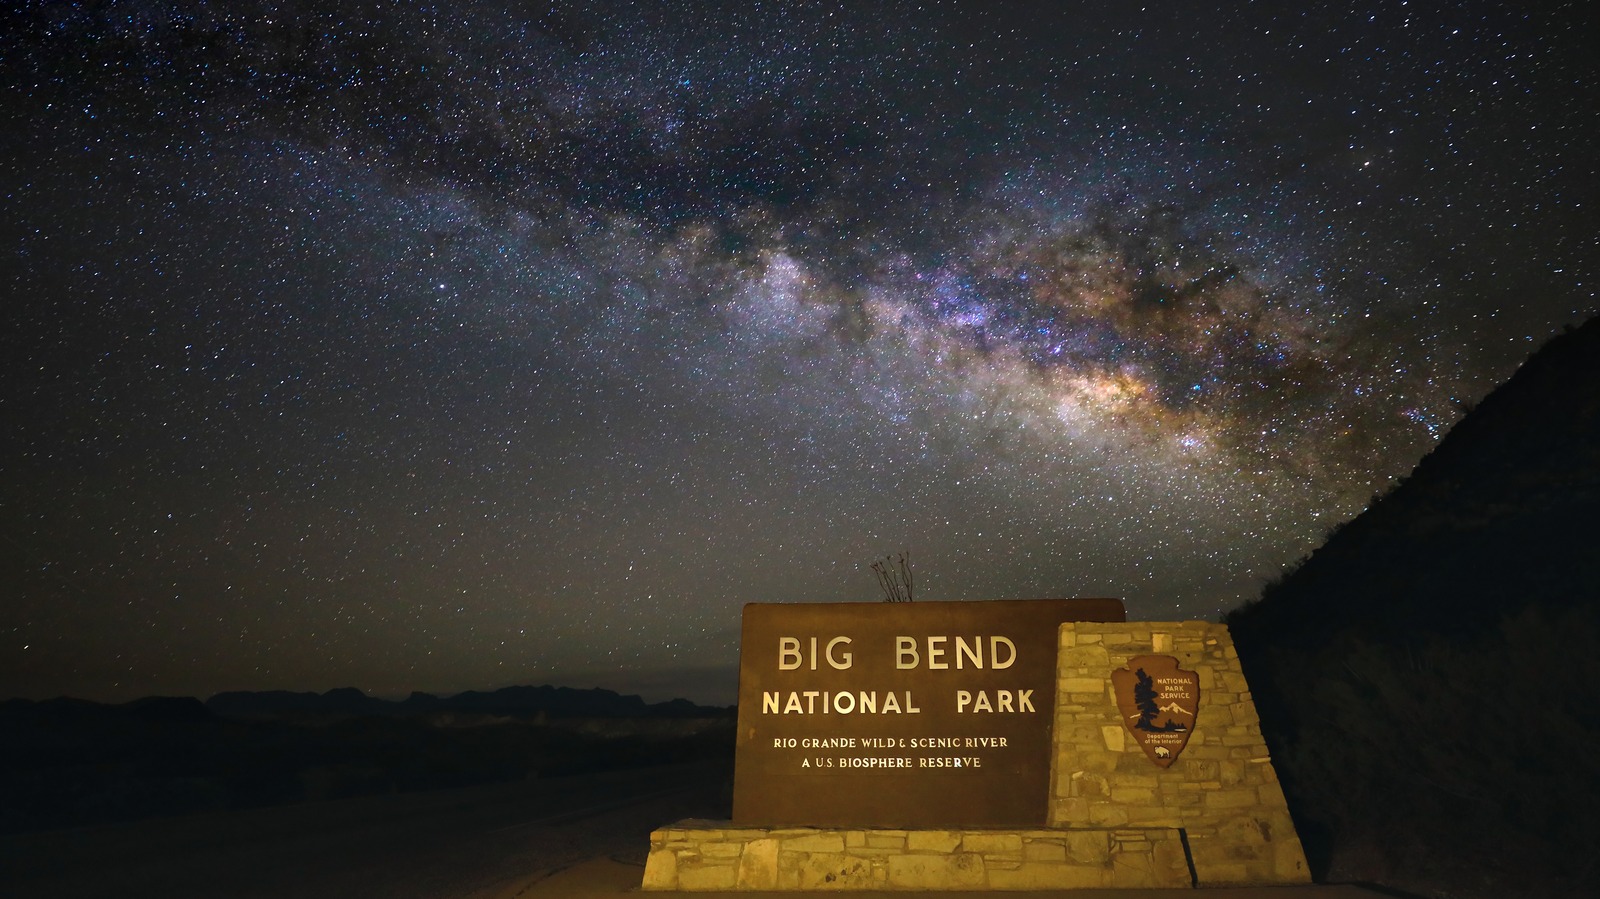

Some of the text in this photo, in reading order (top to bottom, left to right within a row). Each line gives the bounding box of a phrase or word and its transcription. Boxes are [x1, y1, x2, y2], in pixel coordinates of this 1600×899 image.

[779, 636, 1017, 670] BIG BEND
[762, 689, 1036, 714] NATIONAL PARK
[774, 737, 1008, 748] RIO GRANDE WILD & SCENIC RIVER
[801, 757, 981, 768] A U.S. BIOSPHERE RESERVE
